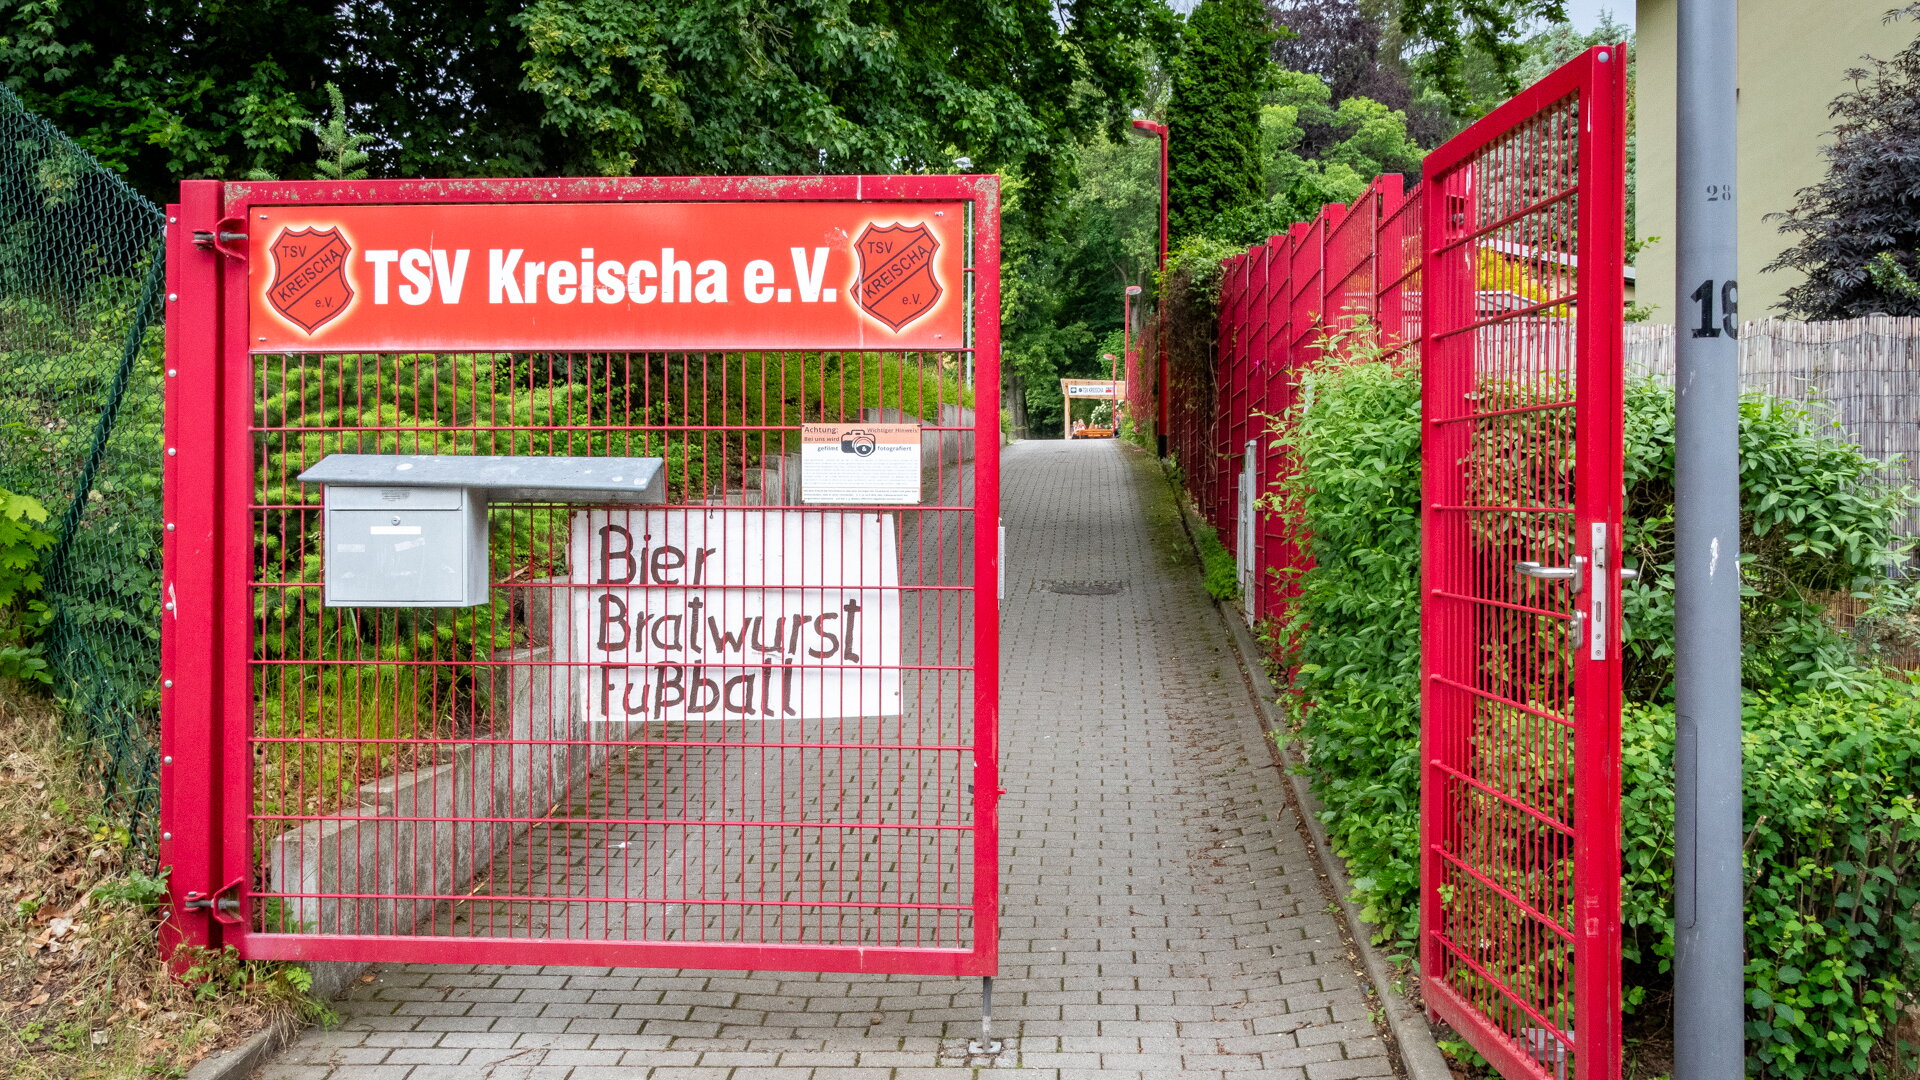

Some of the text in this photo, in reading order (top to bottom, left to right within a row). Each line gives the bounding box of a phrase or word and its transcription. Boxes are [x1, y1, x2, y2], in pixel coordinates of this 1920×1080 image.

[1706, 184, 1732, 202] 28
[281, 245, 307, 258] TSV
[867, 241, 893, 254] TSV
[278, 248, 342, 302] KREISCHA
[365, 246, 838, 305] TSV Kreischa e.V.
[863, 245, 930, 299] KREISCHA
[315, 296, 334, 308] e.V.
[901, 293, 922, 305] e.V.
[804, 426, 839, 435] Achtung:
[866, 427, 894, 435] Wichtiger
[877, 445, 912, 453] fotografiert
[597, 524, 717, 590] Bier
[596, 593, 862, 664] Bratwurst
